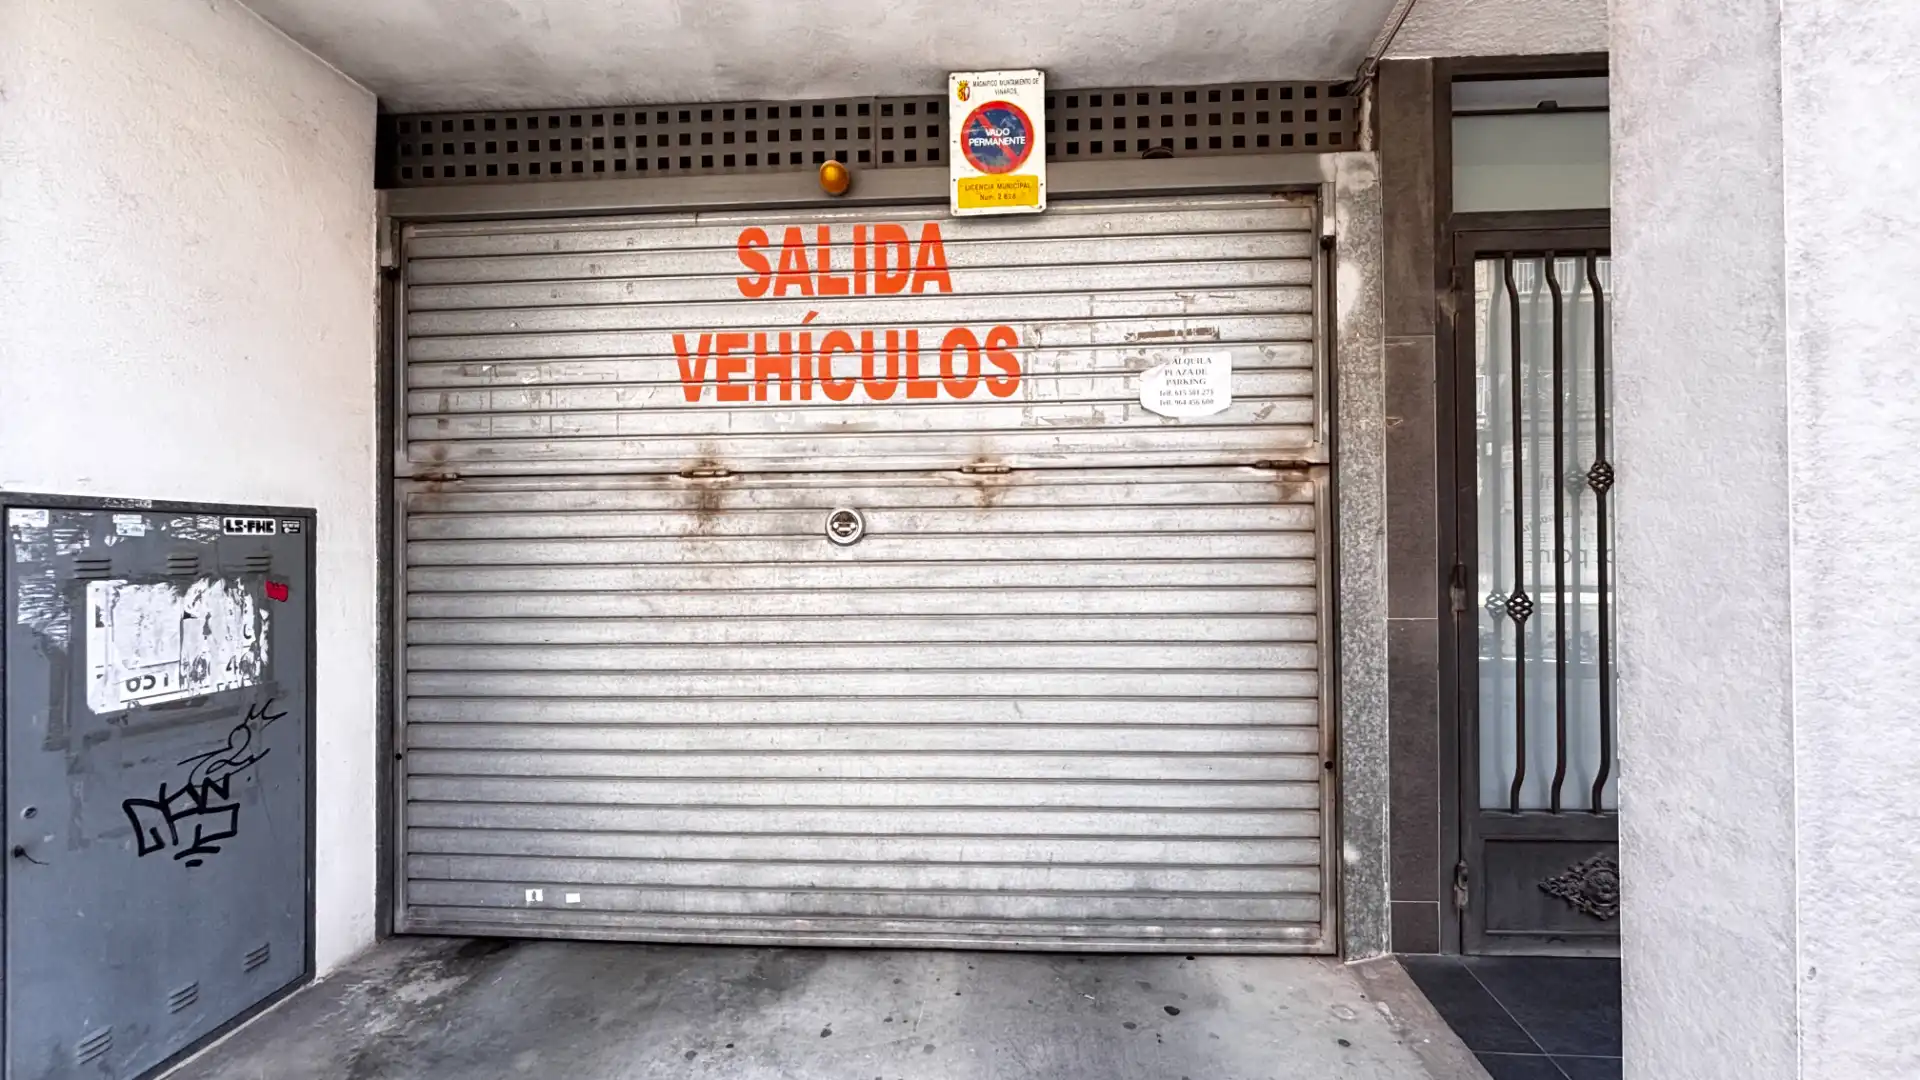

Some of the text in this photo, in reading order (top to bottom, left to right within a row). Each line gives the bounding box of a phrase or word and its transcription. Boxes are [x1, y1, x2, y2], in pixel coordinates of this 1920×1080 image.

[1032, 77, 1039, 85] DE
[985, 128, 1010, 136] VADO
[968, 136, 1026, 147] PERMANENTE
[965, 183, 994, 192] LICENCIA
[997, 181, 1030, 190] MUNICIPAL
[736, 223, 953, 298] SALIDA
[672, 310, 1021, 402] VEHÍCULOS
[1172, 357, 1212, 366] ALQUILA
[1164, 368, 1194, 376] PLAZA
[1166, 378, 1206, 386] PARKING
